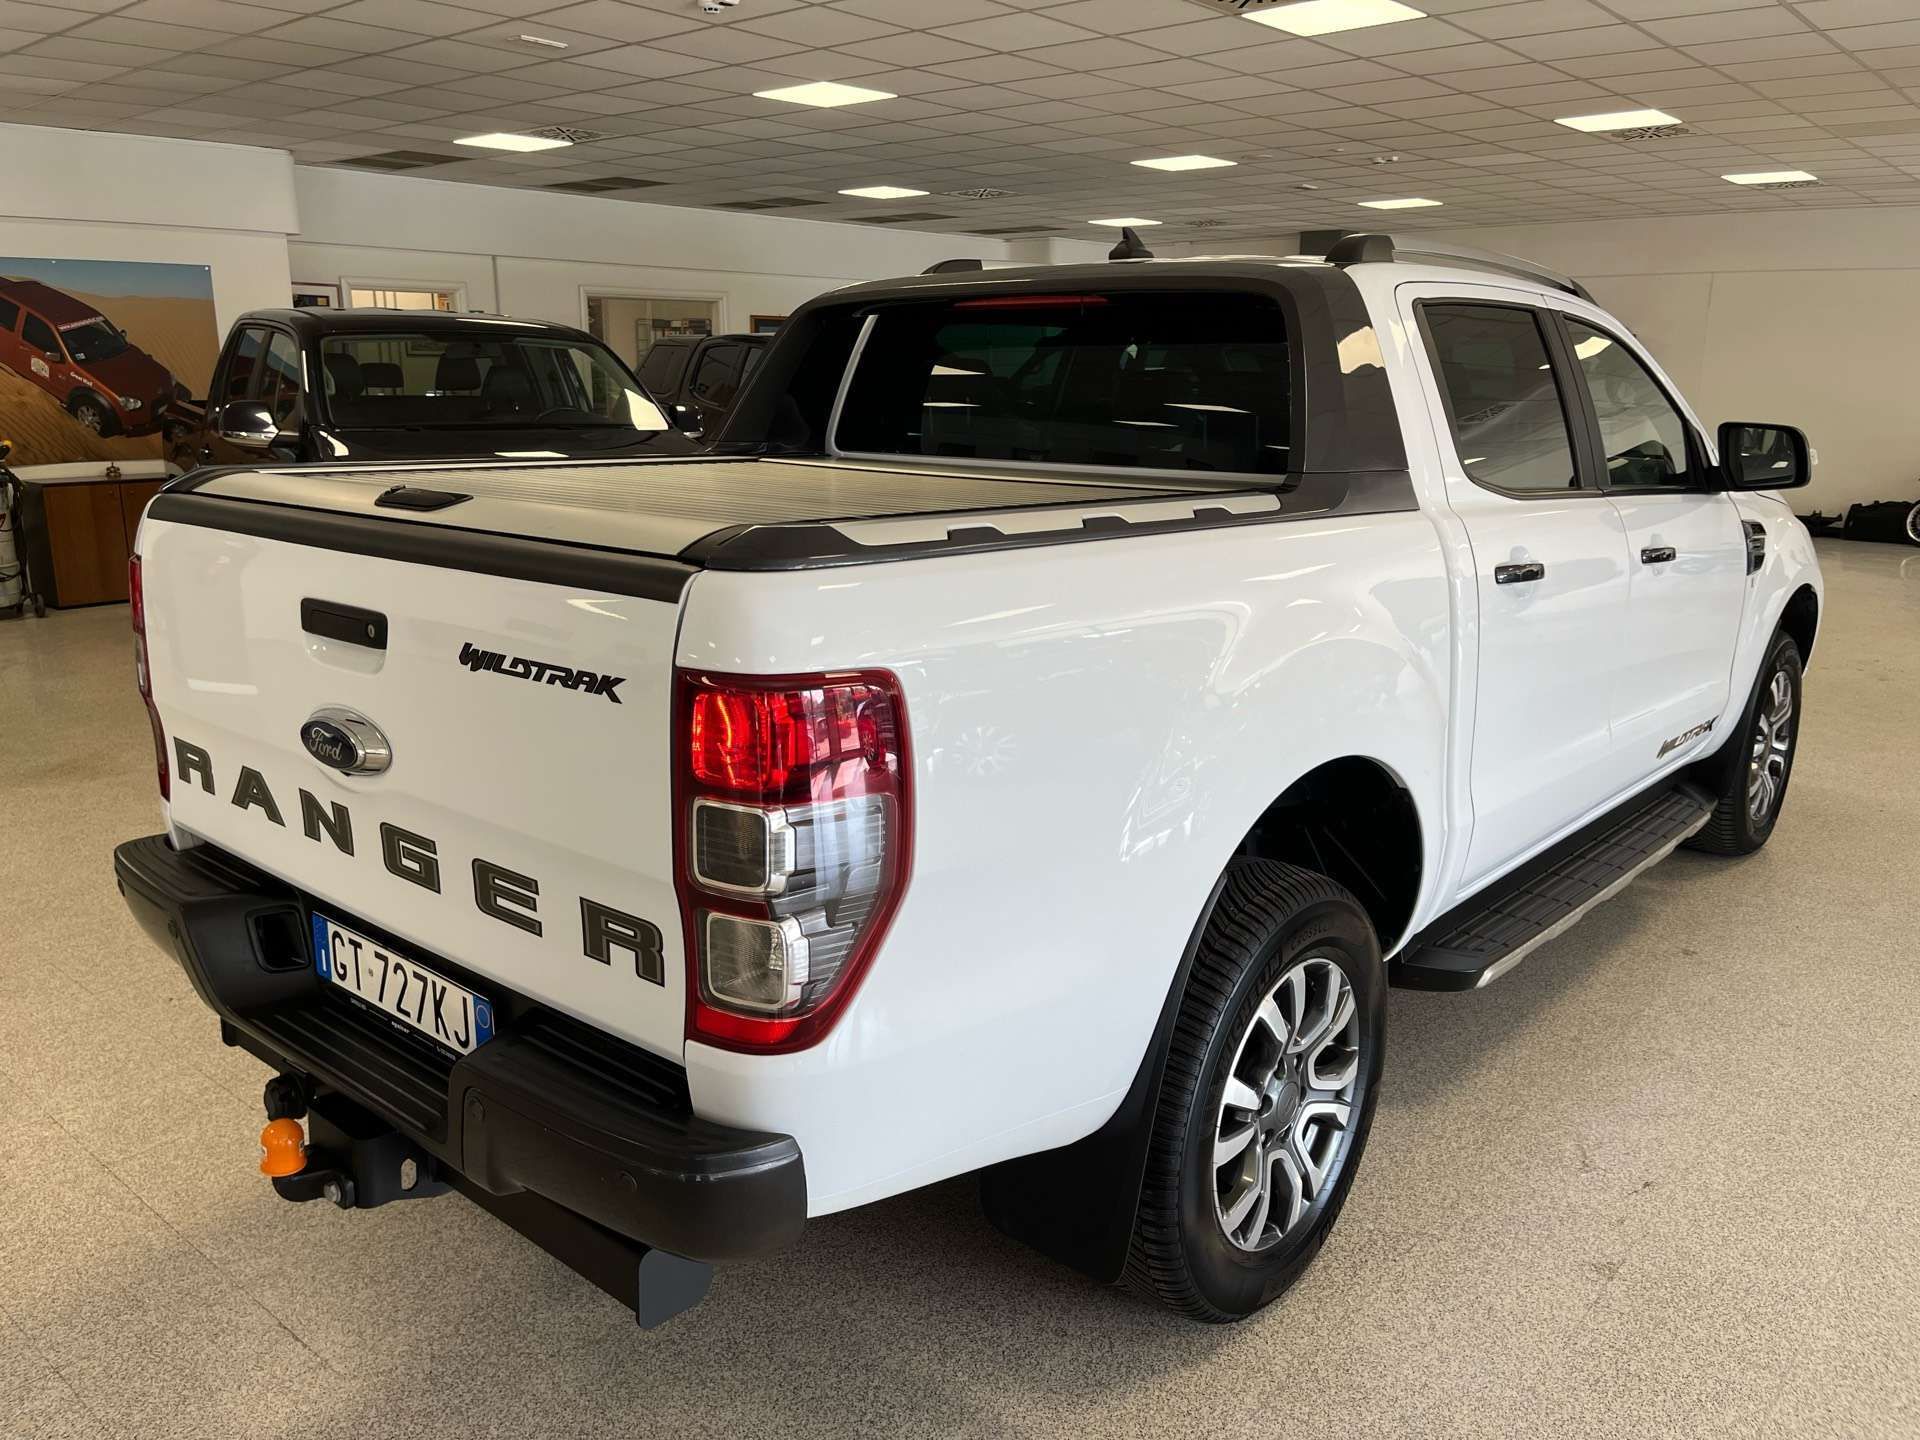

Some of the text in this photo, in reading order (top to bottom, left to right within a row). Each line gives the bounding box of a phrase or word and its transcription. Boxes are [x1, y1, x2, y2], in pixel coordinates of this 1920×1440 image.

[458, 641, 627, 705] WILDTRAK
[309, 726, 343, 761] Ford
[173, 736, 665, 988] RANGER
[331, 930, 363, 992] GT
